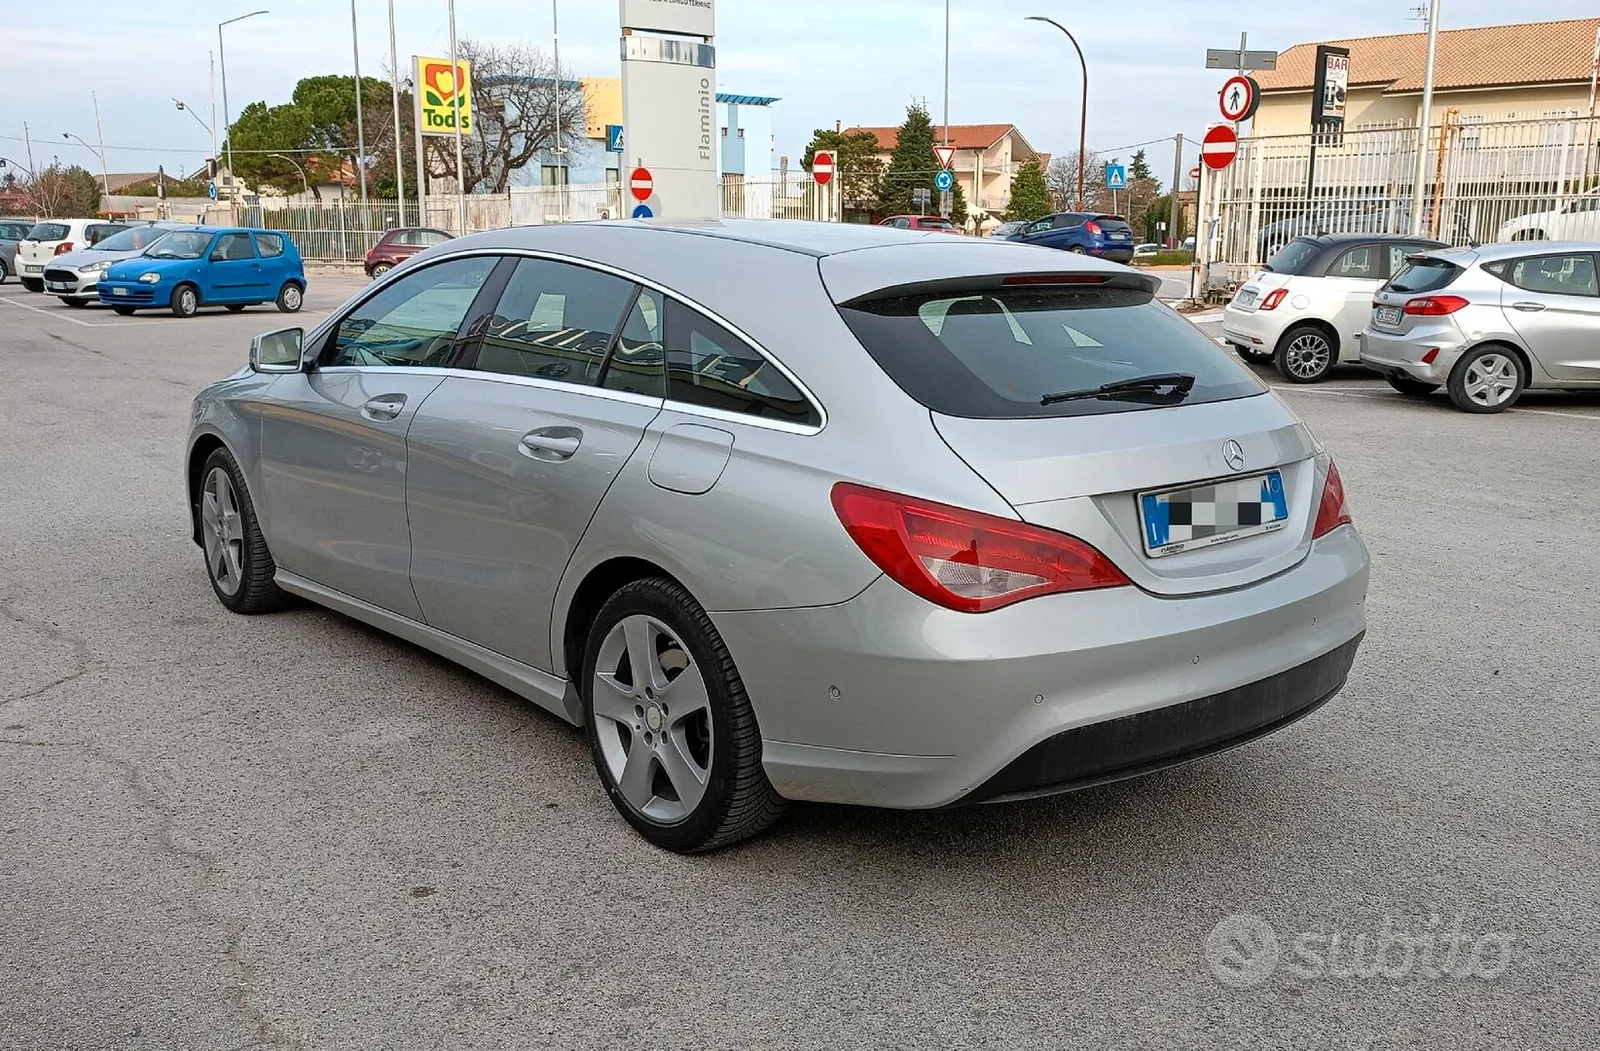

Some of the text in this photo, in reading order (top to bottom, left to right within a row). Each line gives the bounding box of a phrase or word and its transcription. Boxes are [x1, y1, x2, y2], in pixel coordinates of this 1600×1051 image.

[689, 0, 711, 9] TERMINE
[1328, 58, 1348, 70] BAR
[423, 109, 469, 128] Tods
[698, 78, 710, 160] Flaminio
